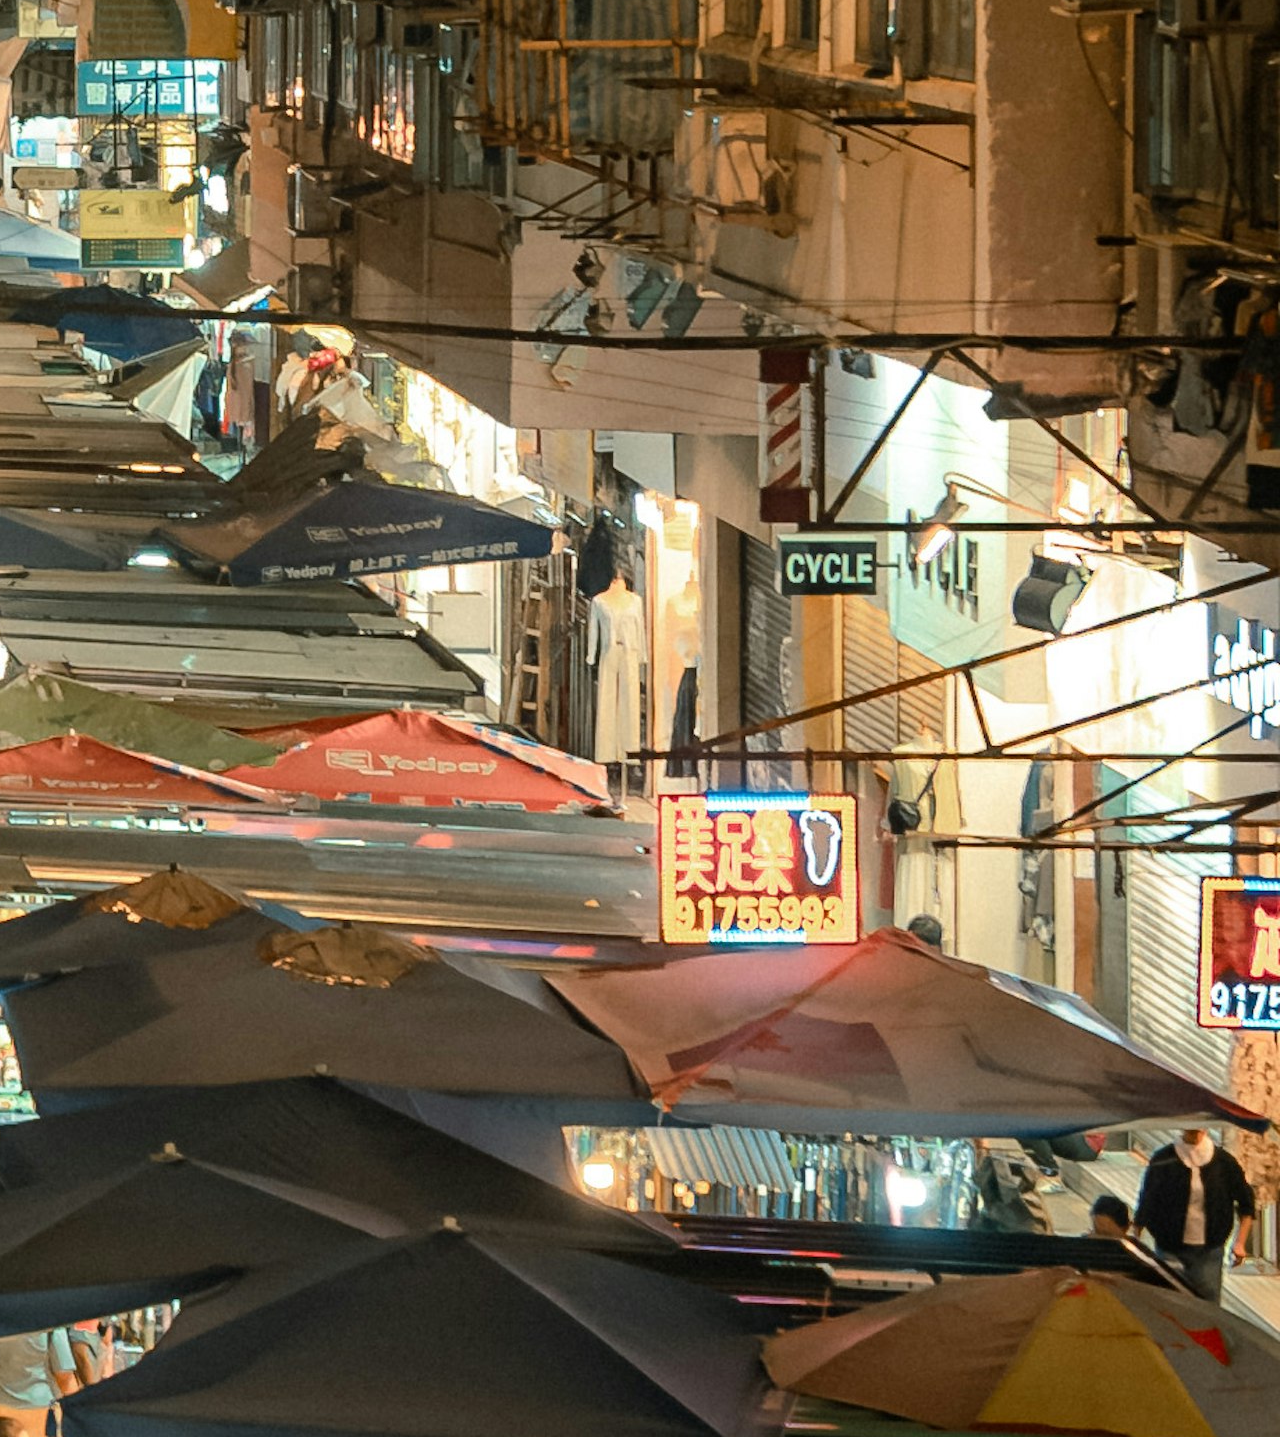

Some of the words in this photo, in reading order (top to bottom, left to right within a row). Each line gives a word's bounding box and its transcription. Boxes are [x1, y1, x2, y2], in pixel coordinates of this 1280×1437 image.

[349, 516, 444, 538] Yedpay
[284, 563, 336, 581] Yedpay
[786, 552, 874, 584] CYCLE
[379, 754, 498, 775] Yedpay
[675, 895, 844, 932] 91755993
